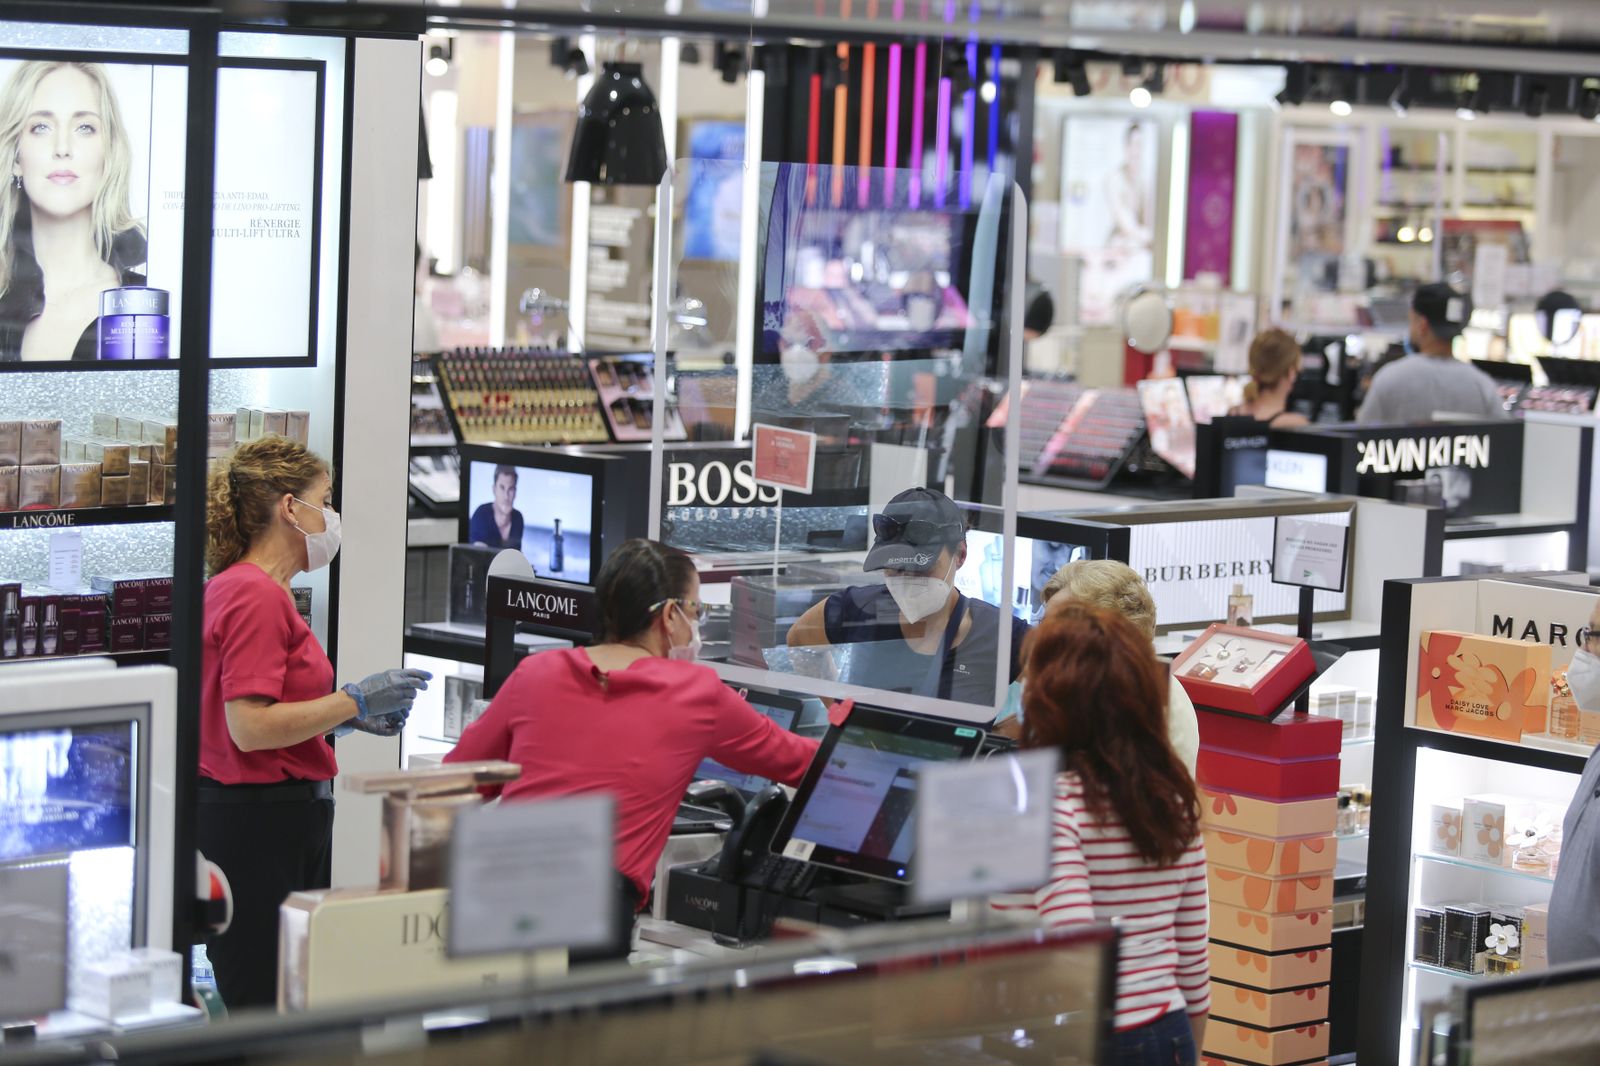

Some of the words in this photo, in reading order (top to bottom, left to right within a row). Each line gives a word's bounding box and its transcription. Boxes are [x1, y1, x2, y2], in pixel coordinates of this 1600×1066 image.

[163, 191, 186, 200] TRIPL
[250, 217, 301, 228] RÉNERGIE
[213, 228, 264, 238] ULTI-LIFT
[267, 228, 301, 238] ULTRA
[13, 512, 75, 528] LANCÔME
[1144, 559, 1273, 583] BURBERRY
[146, 578, 174, 587] LANCÔM
[533, 611, 550, 620] PARIS
[1450, 699, 1470, 707] DAISY
[1445, 704, 1464, 712] MARC
[1466, 709, 1494, 717] JACOBS
